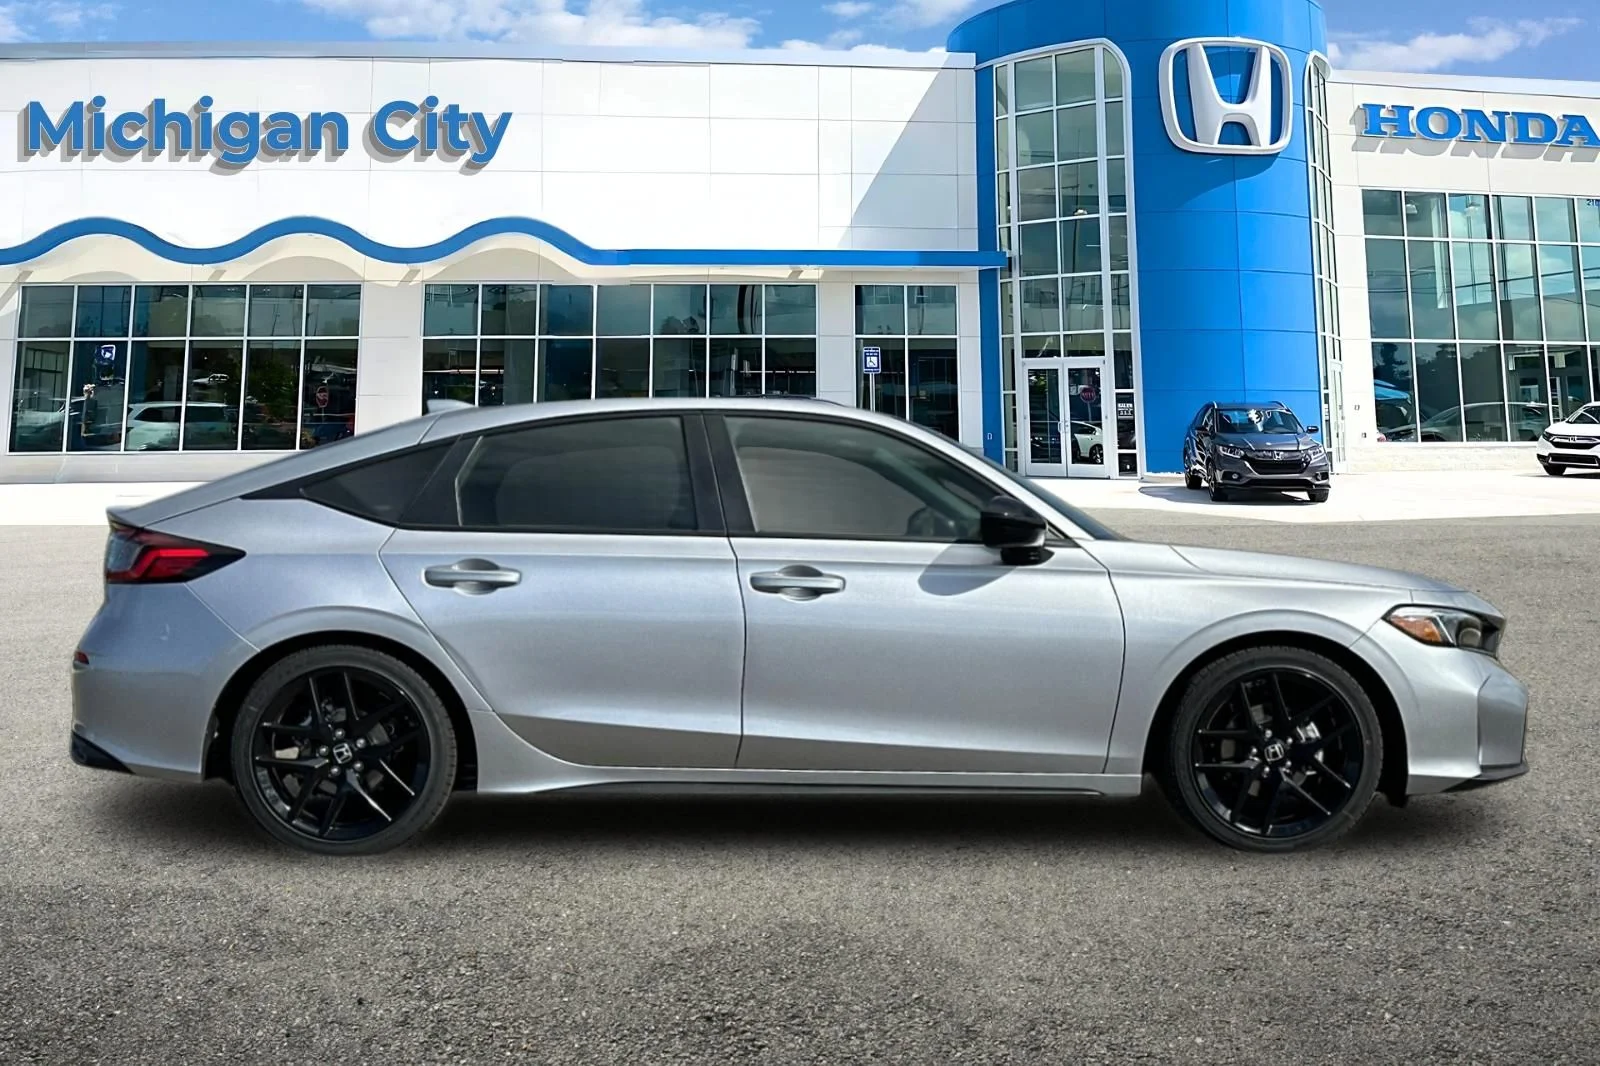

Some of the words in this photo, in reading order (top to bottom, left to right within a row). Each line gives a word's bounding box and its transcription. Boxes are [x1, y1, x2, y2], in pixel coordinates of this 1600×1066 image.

[27, 95, 349, 163] Michigan
[374, 95, 512, 163] City
[1361, 103, 1600, 147] HONDA
